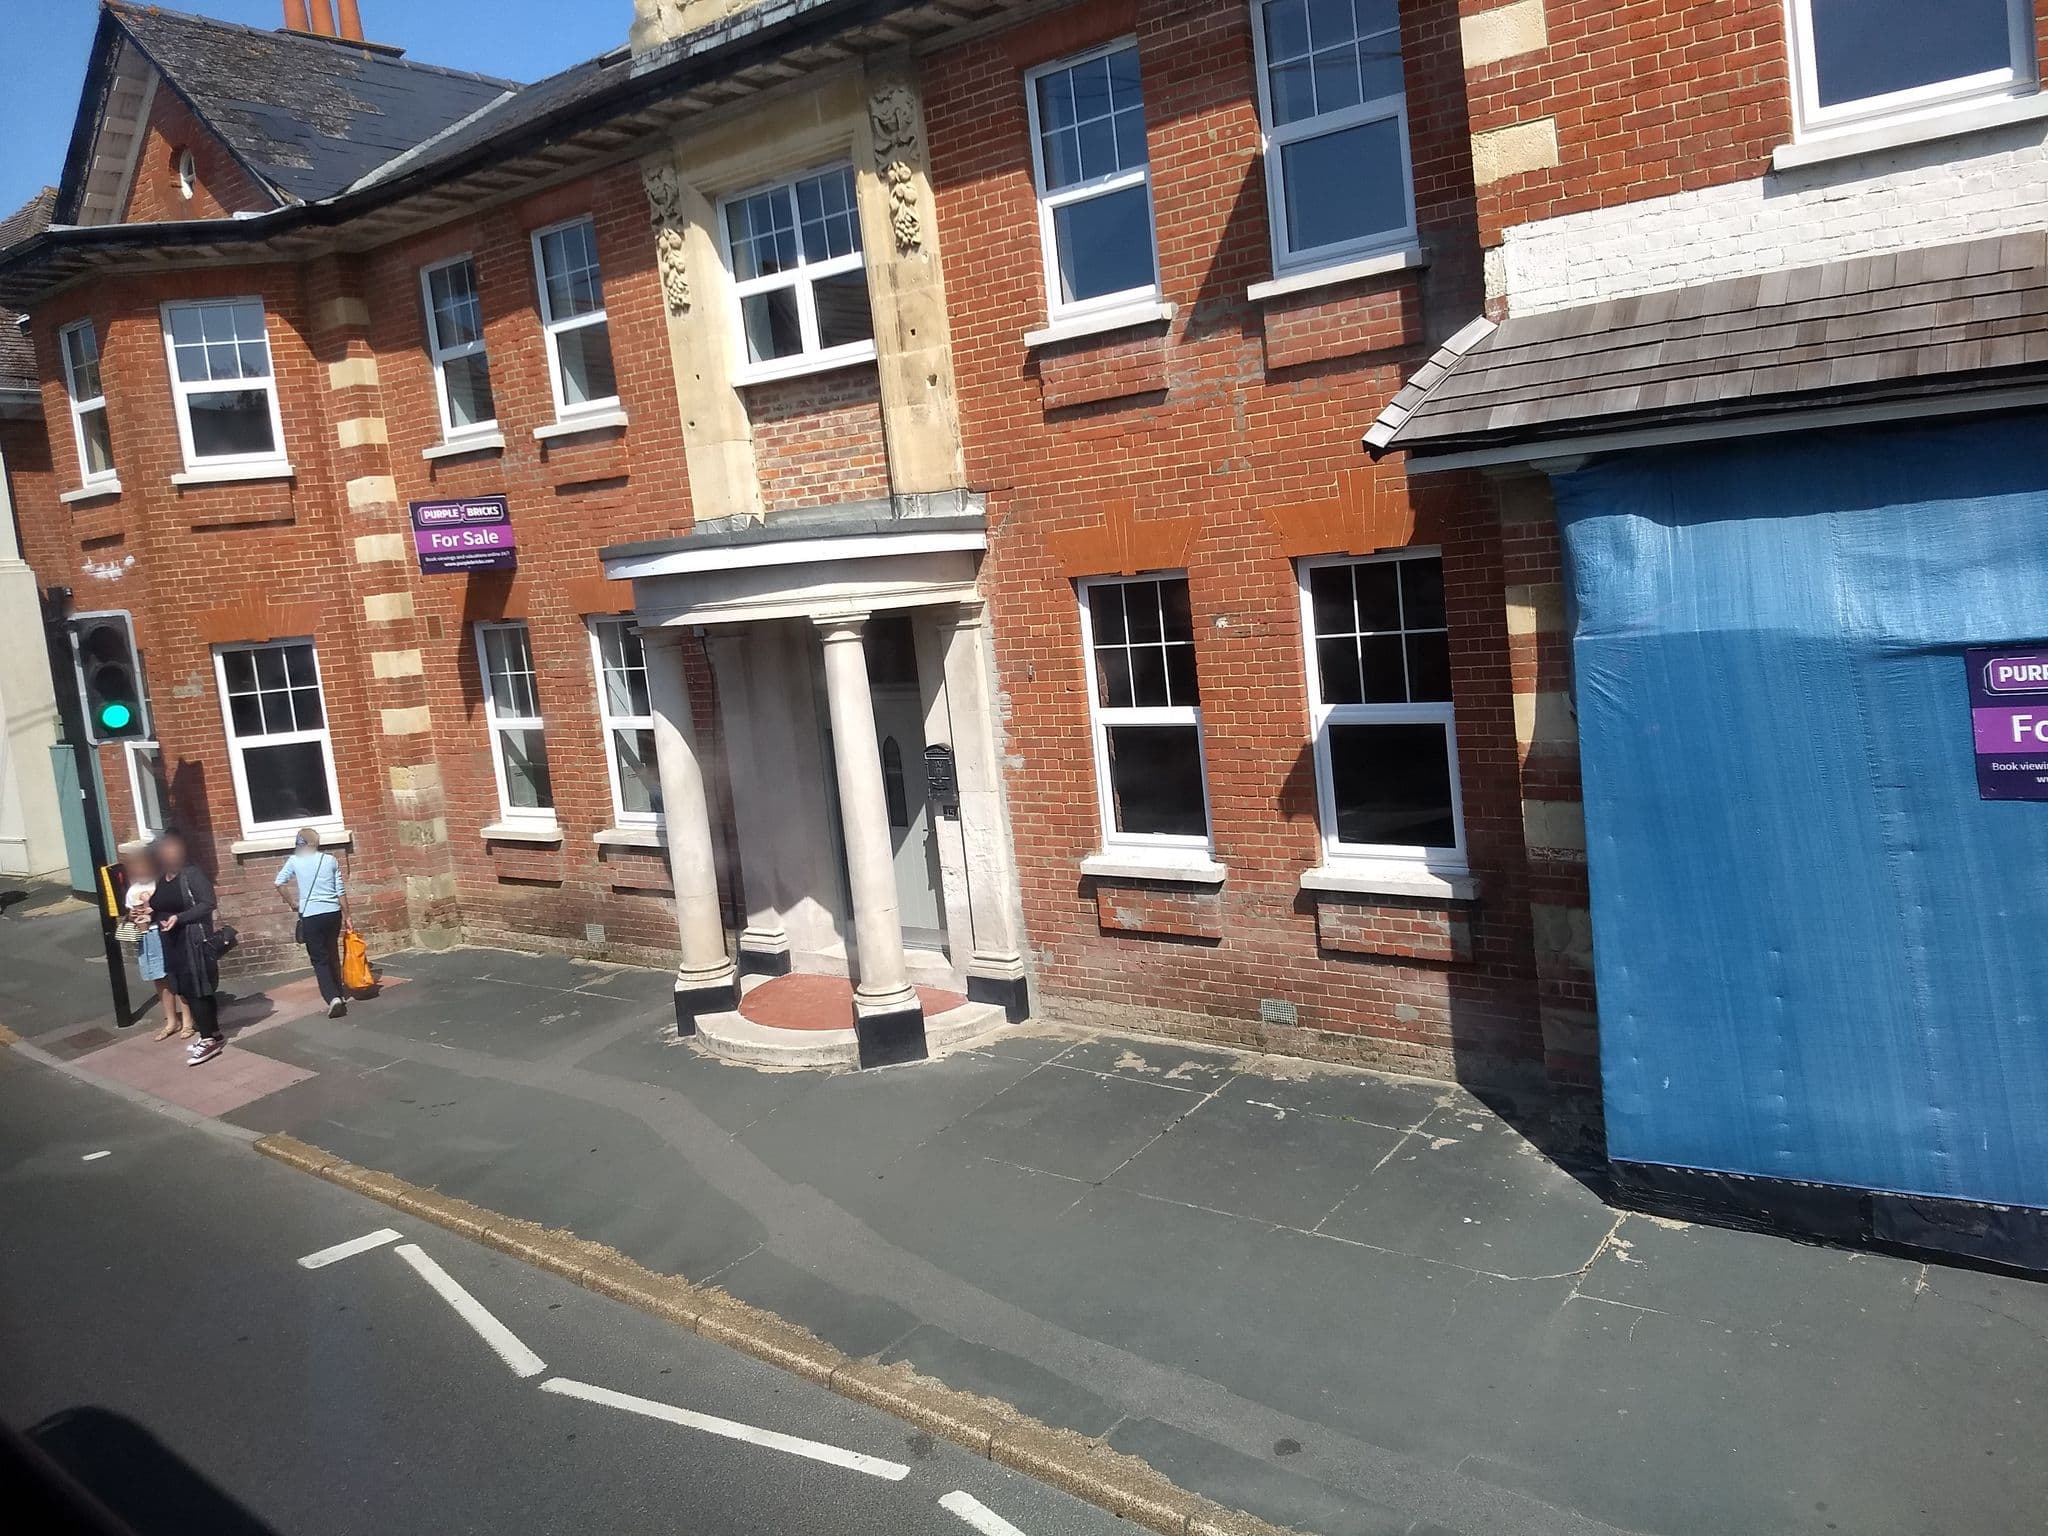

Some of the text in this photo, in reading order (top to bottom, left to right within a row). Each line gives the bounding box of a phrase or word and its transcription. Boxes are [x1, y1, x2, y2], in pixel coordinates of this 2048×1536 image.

[424, 506, 499, 519] PURPLE BRICKS
[432, 529, 499, 548] For Sale
[1992, 761, 2018, 771] Book
